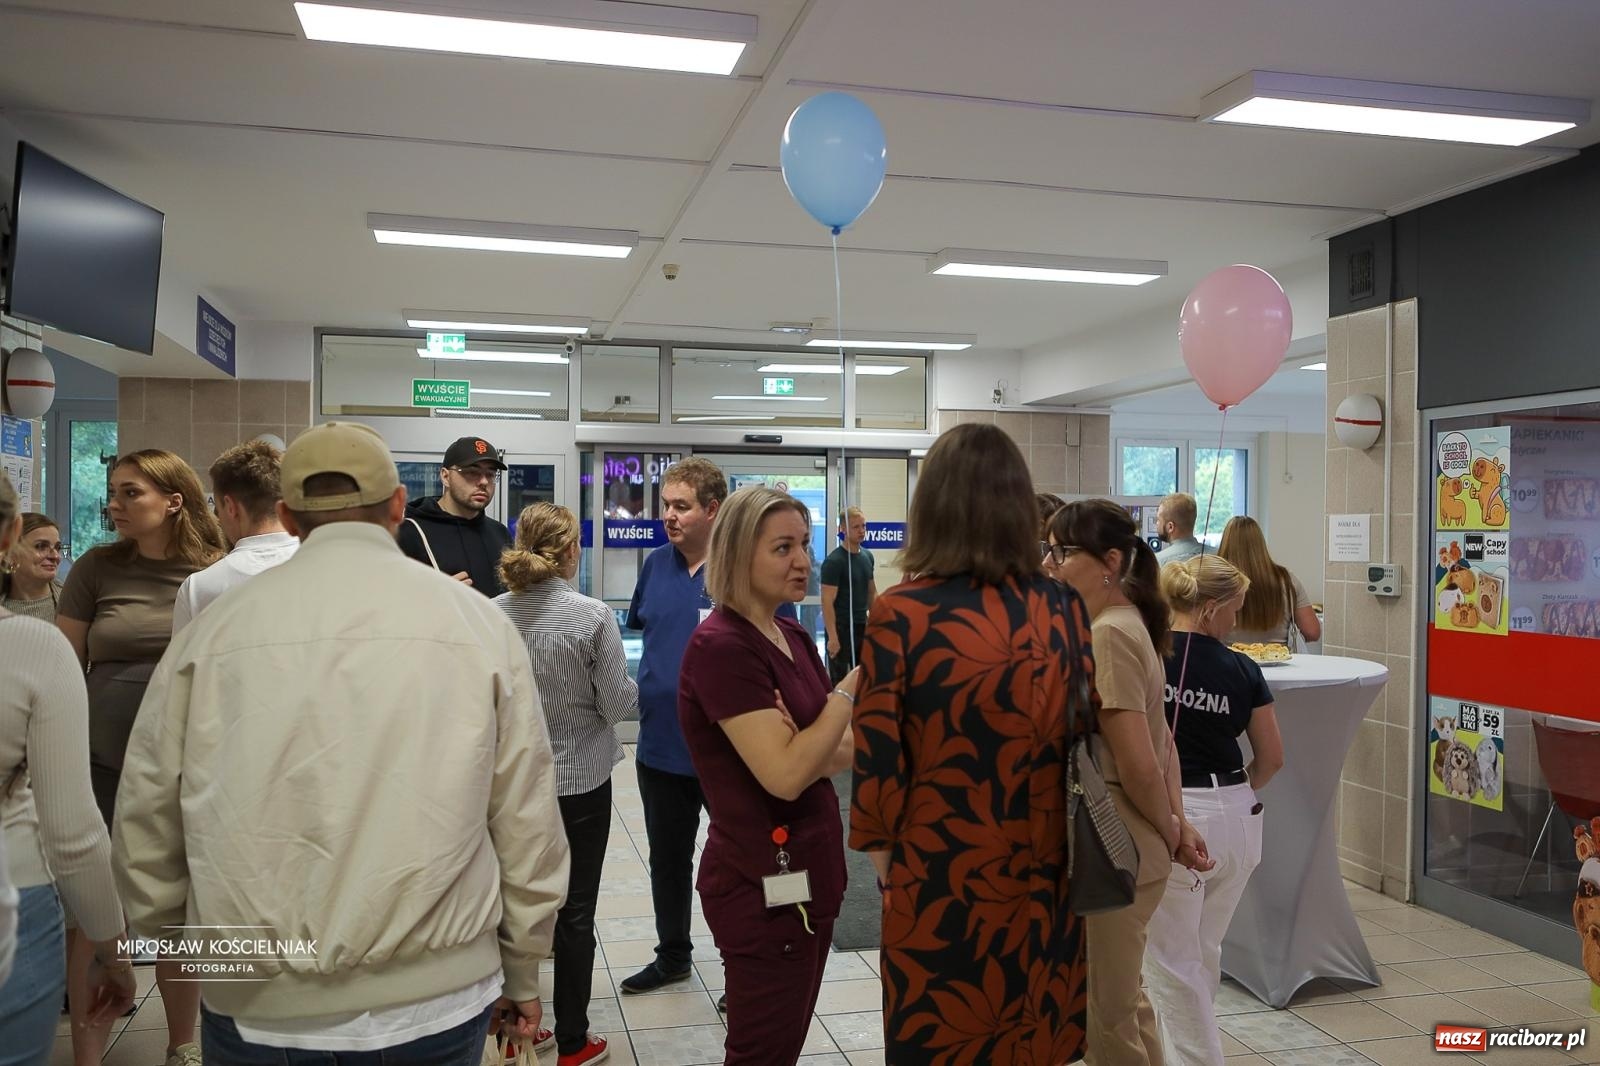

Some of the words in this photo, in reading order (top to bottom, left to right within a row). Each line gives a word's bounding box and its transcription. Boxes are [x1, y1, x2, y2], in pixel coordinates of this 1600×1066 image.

[417, 383, 465, 394] WYJŚCIE
[414, 395, 467, 403] EWAKUACYJNE
[1442, 443, 1457, 452] BACK
[1458, 441, 1467, 450] TO
[1444, 452, 1467, 460] SCHOOL
[1443, 461, 1450, 470] IS
[607, 525, 654, 539] WYJŚCIE
[1465, 543, 1483, 551] NEW
[1486, 539, 1507, 549] Capy
[1462, 706, 1476, 715] MA
[1462, 713, 1476, 722] SKO
[1483, 714, 1500, 729] 59
[1462, 721, 1476, 730] TKI
